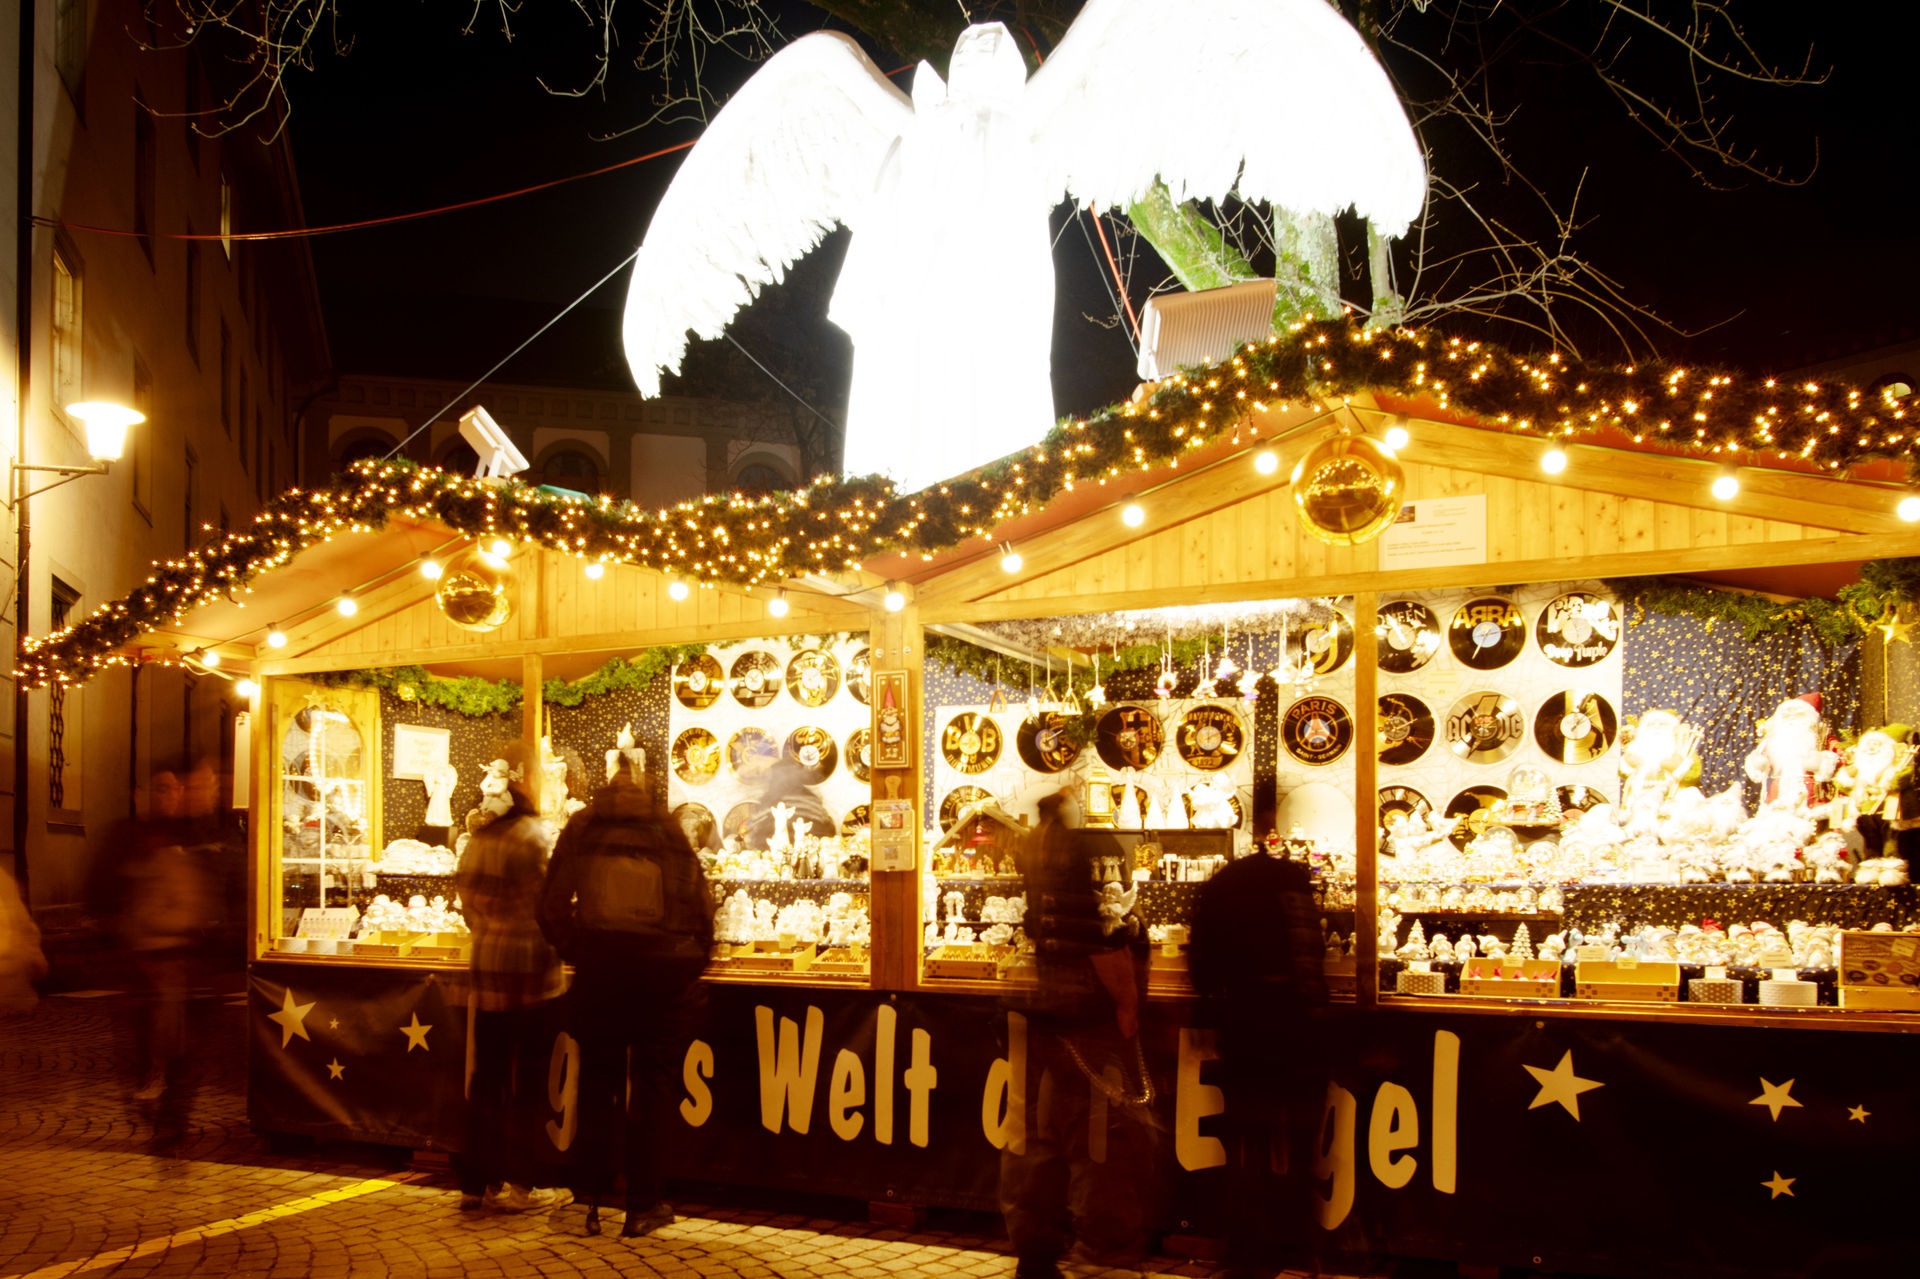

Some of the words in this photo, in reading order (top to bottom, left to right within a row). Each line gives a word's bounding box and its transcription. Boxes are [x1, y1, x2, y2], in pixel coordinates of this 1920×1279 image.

[1453, 604, 1522, 629] ABBA
[1573, 641, 1608, 661] Purple
[1291, 700, 1337, 719] PARIS
[755, 1003, 938, 1149] Welt
[1175, 1027, 1461, 1230] Egel
